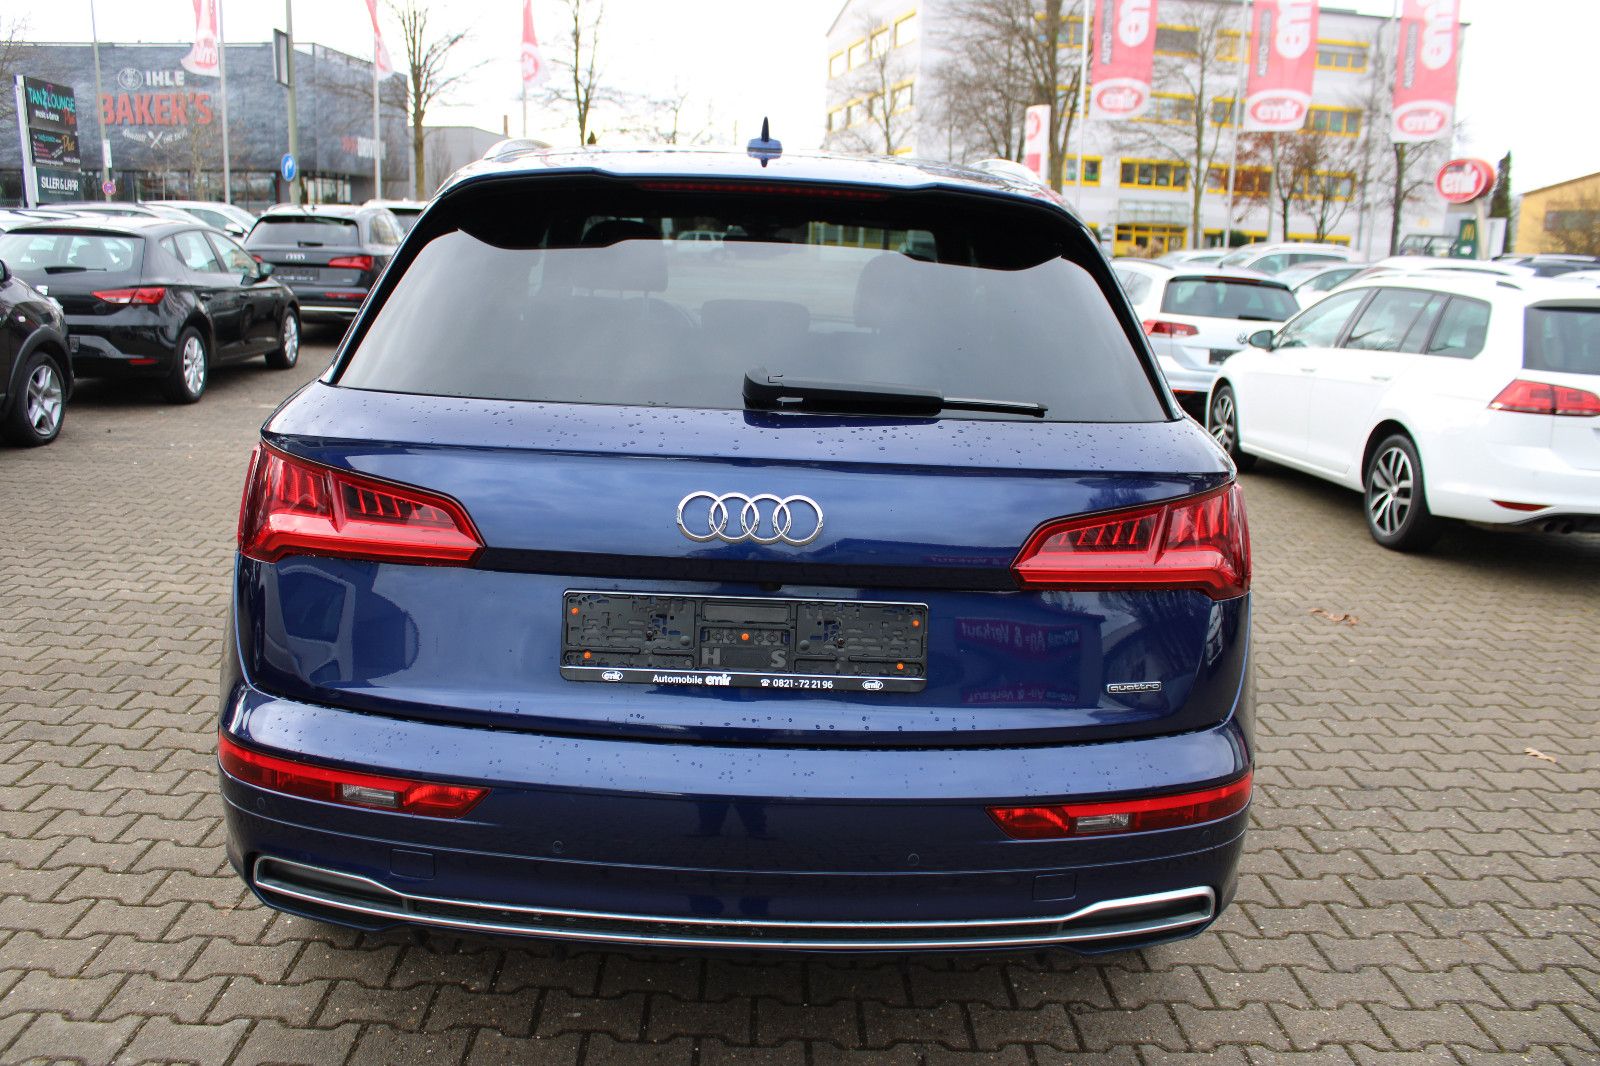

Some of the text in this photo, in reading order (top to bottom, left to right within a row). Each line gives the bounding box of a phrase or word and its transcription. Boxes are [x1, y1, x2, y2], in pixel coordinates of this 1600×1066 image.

[146, 70, 184, 86] IHLE
[97, 91, 214, 126] BAKER'S
[1441, 162, 1478, 194] emir
[652, 673, 731, 685] Automobile emir
[772, 678, 794, 688] 0821
[1110, 683, 1160, 692] quattro
